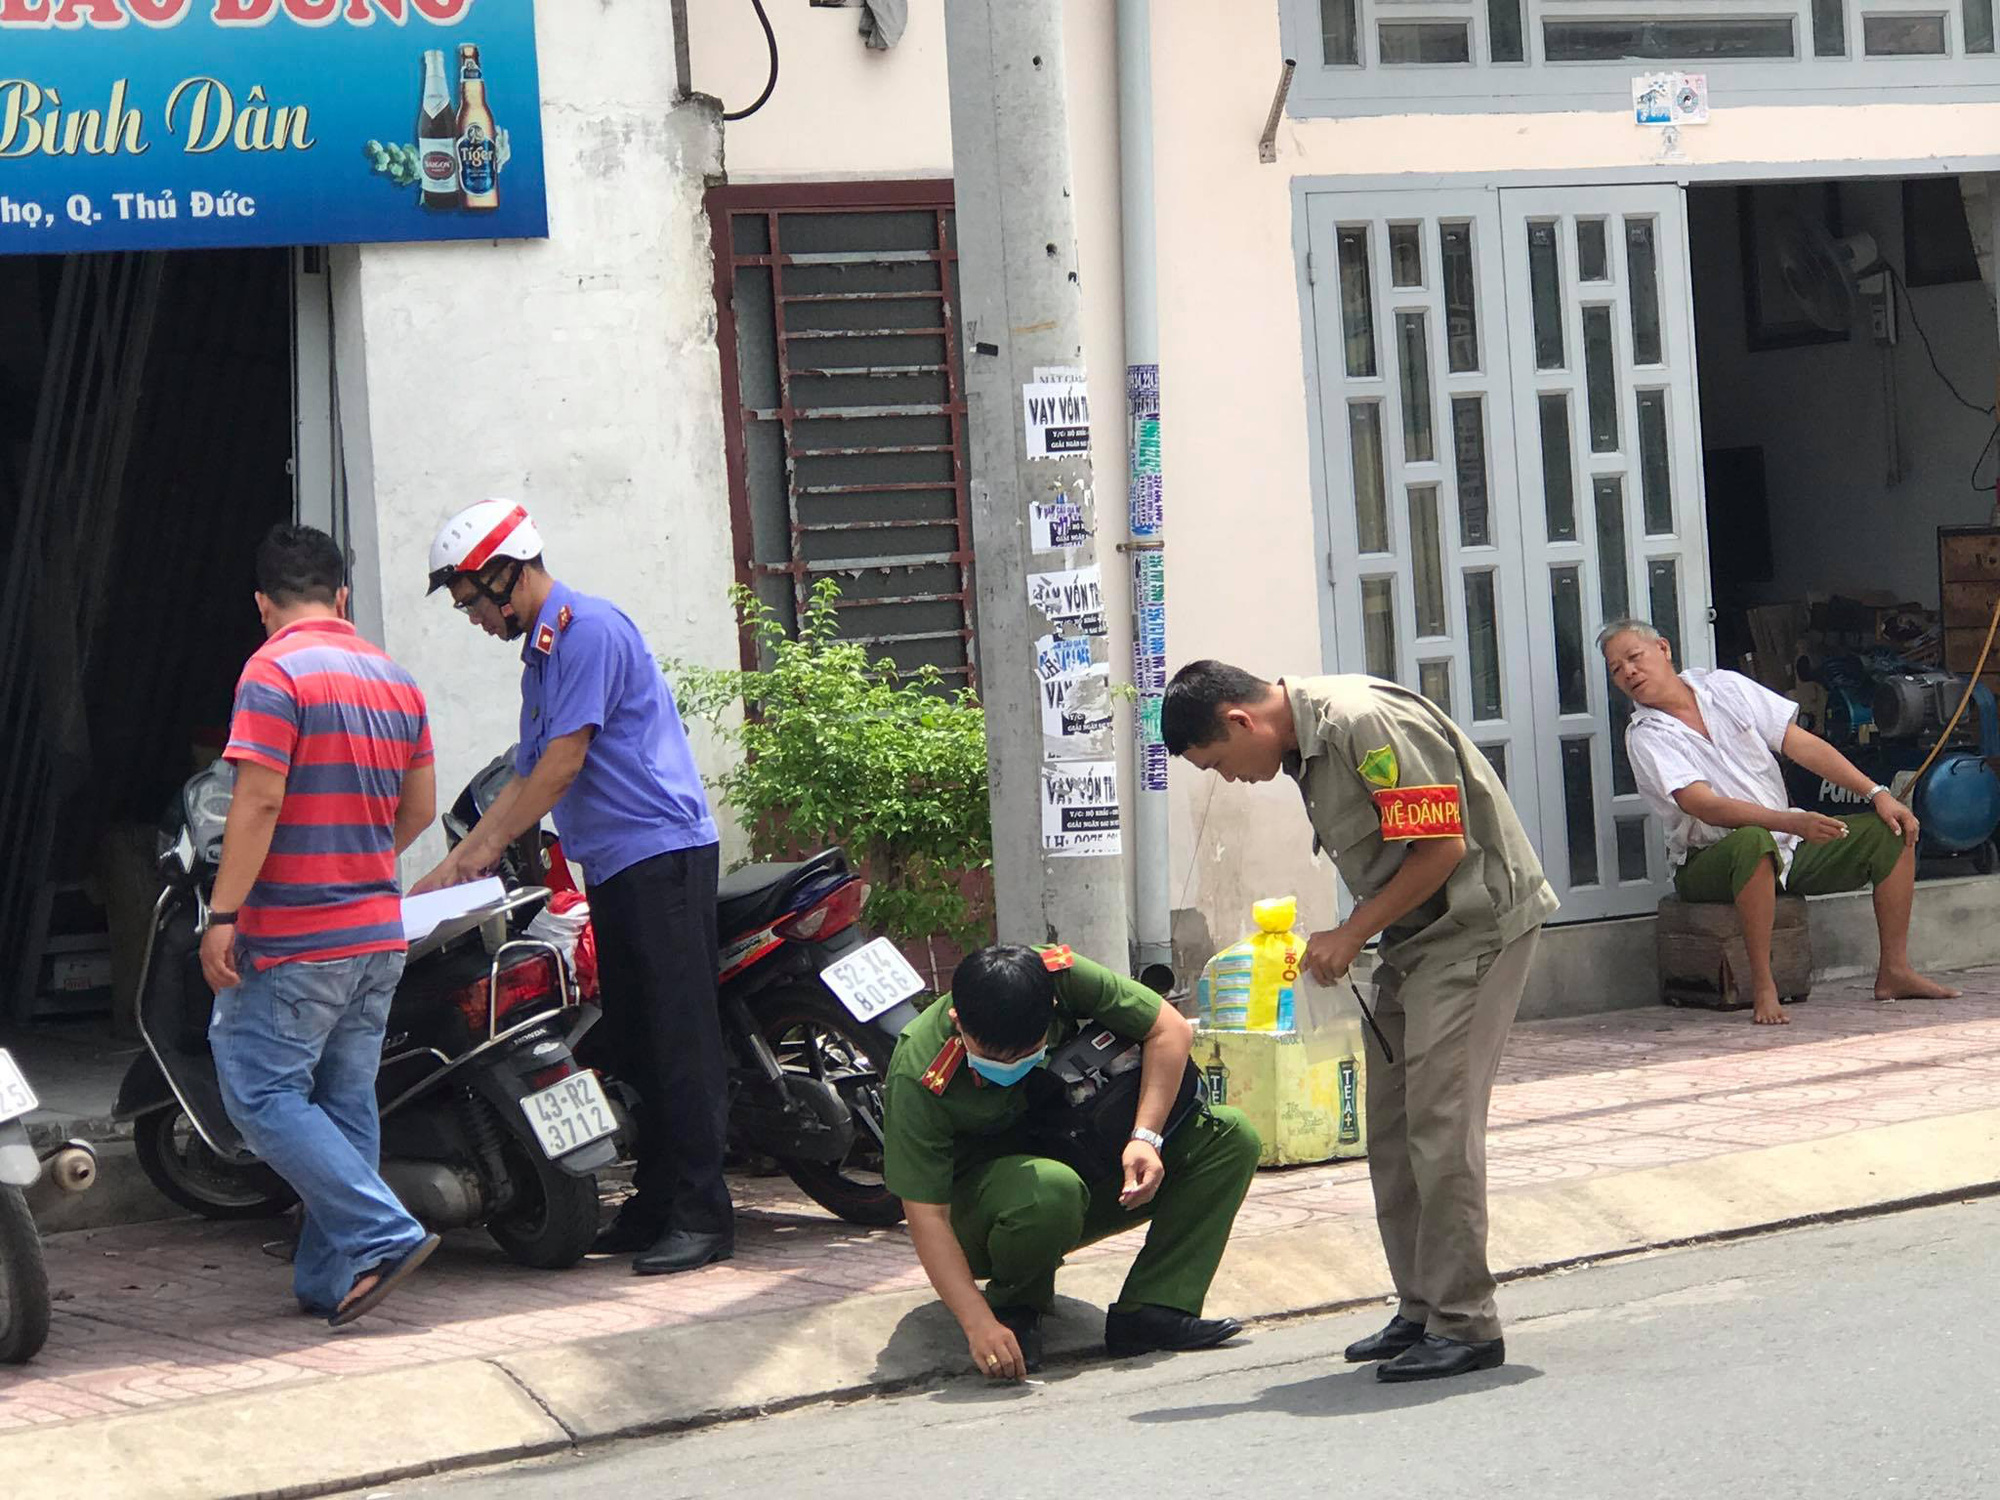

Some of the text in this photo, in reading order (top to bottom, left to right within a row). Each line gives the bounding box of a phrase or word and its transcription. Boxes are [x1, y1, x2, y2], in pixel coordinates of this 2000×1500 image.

[0, 76, 315, 158] Bình Dân
[461, 146, 494, 167] Tiger
[67, 194, 102, 226] Q.
[112, 189, 177, 220] Thủ
[190, 189, 256, 218] Đức
[1029, 397, 1056, 426] VAY
[1385, 800, 1405, 828] VỆ
[1408, 798, 1444, 825] DÂN
[833, 949, 892, 990] 52-X4
[854, 970, 912, 1012] 8056
[513, 1027, 548, 1046] HONDA
[535, 1079, 596, 1121] 43-R2
[548, 1106, 610, 1150] 3712
